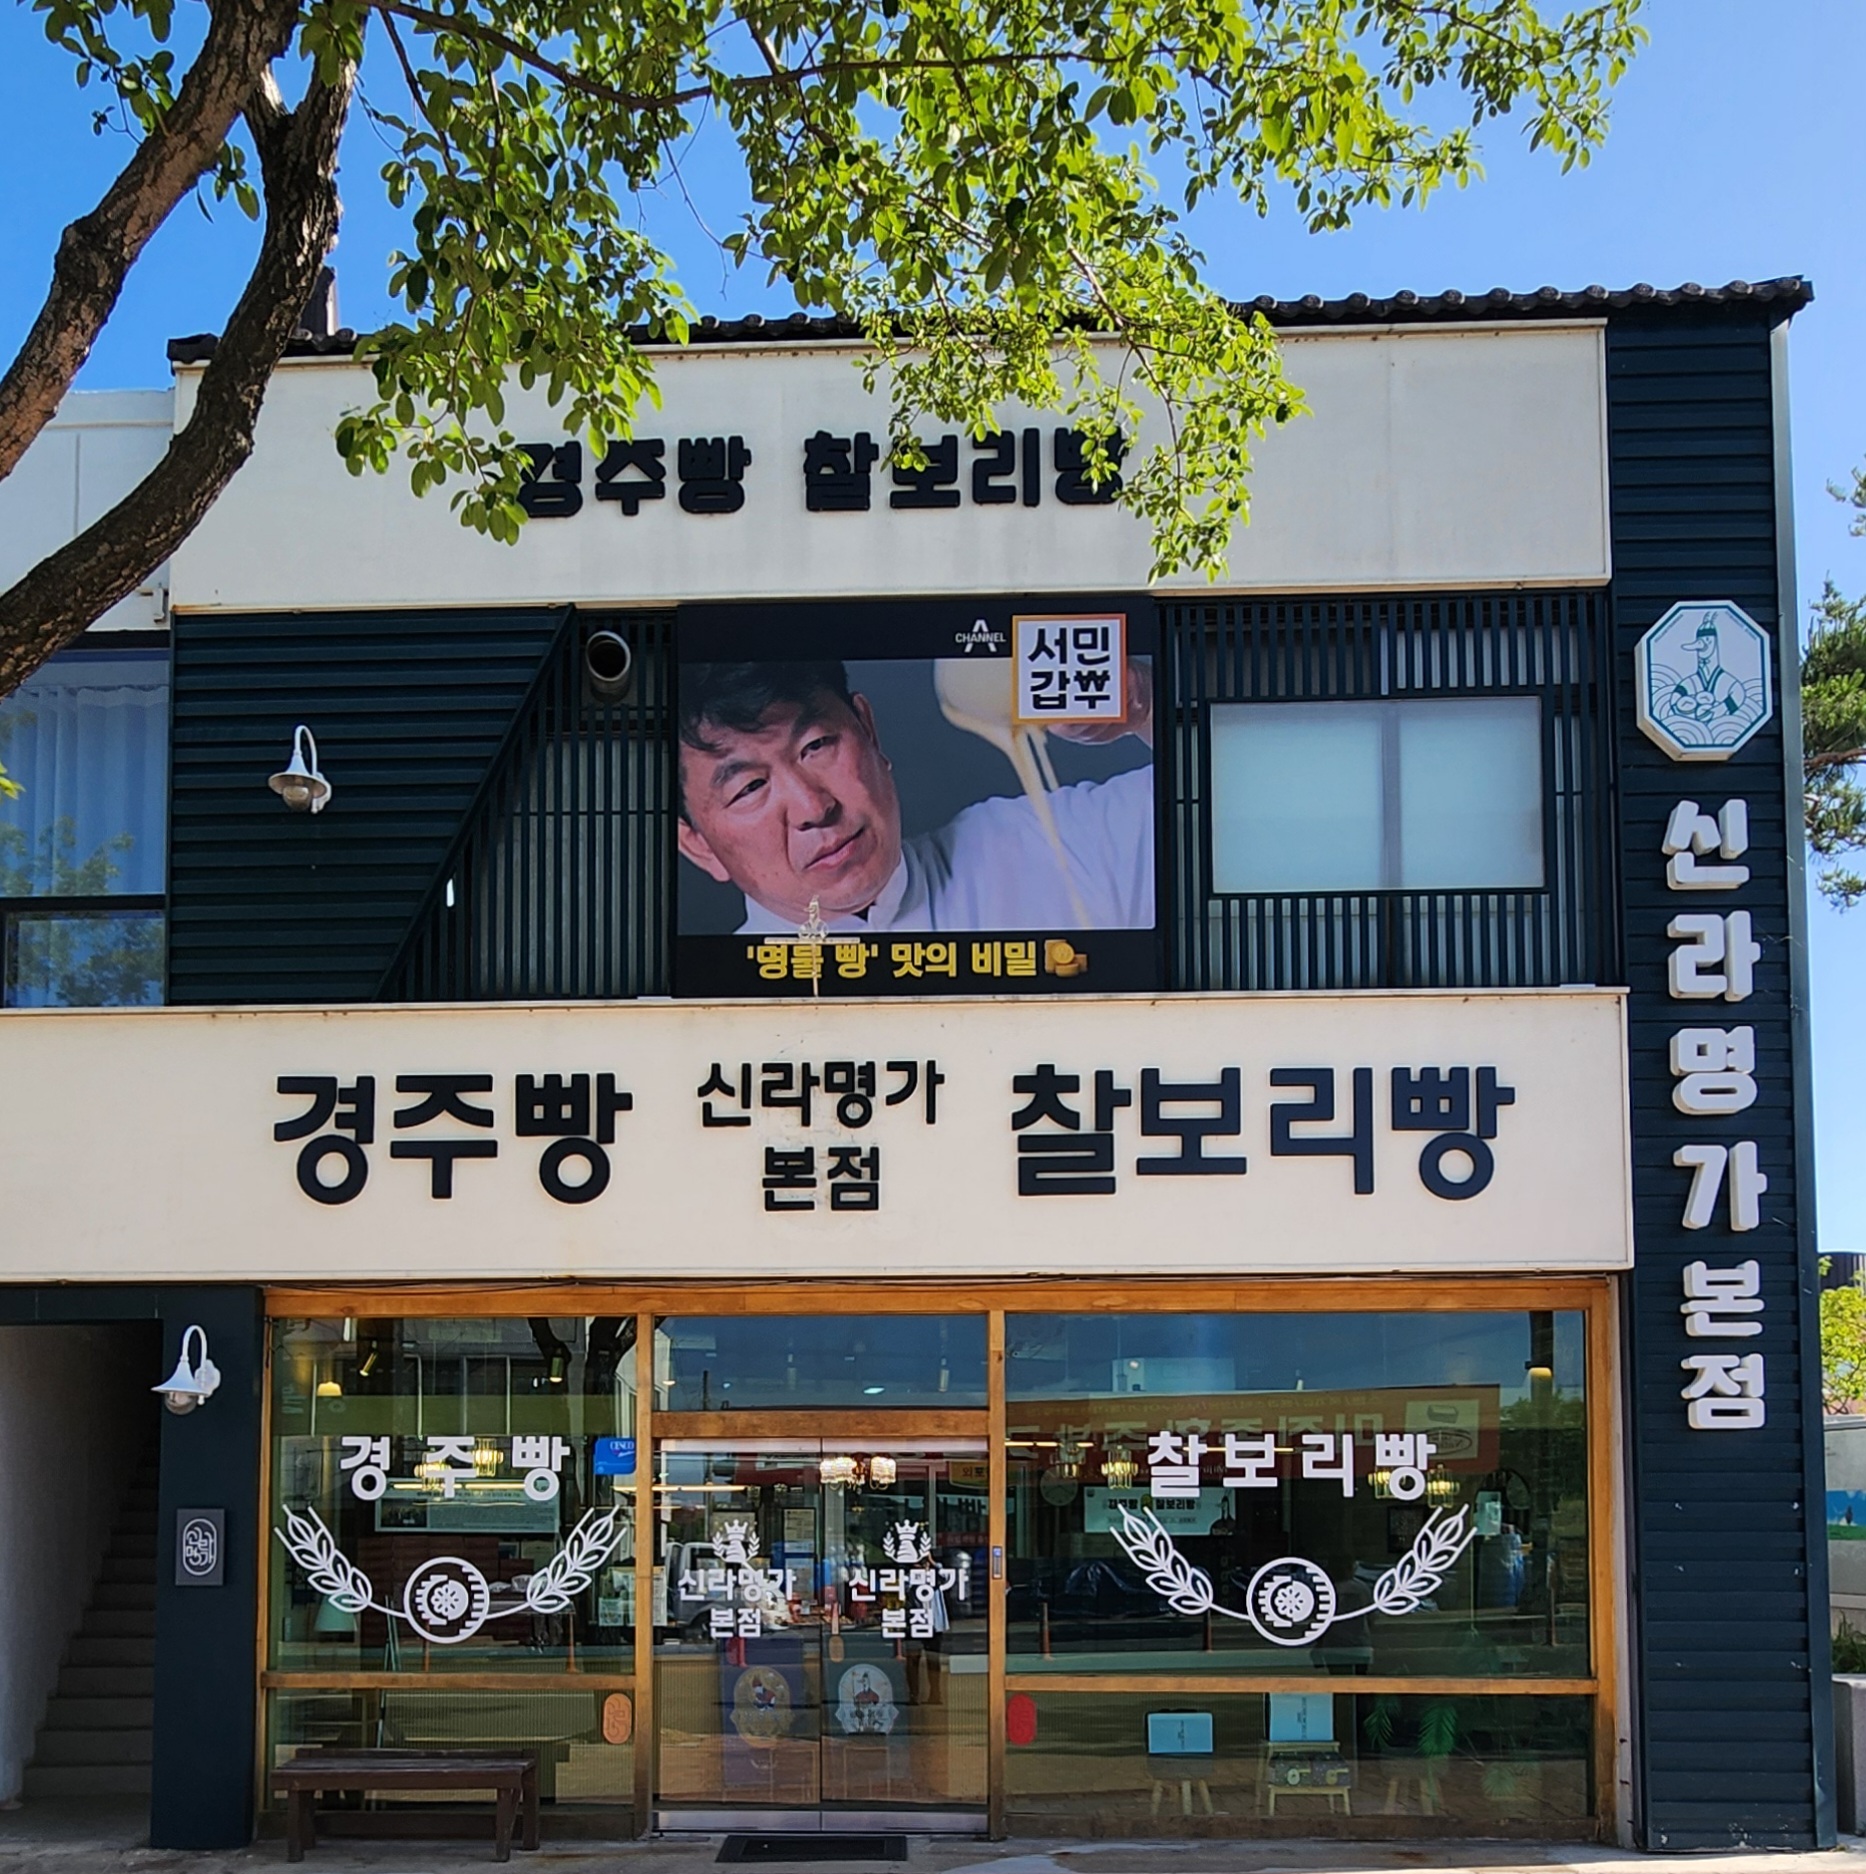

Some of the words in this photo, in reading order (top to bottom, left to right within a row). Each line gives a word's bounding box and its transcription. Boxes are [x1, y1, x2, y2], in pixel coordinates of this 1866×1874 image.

[517, 435, 751, 517] 경주빵
[803, 427, 1133, 512] 찰보리빵
[955, 632, 1006, 643] CHANNEL
[1027, 627, 1110, 666] 서민
[892, 942, 957, 977] 맛의
[972, 941, 1037, 976] 비밀
[698, 1060, 945, 1128] 신라명가
[274, 1073, 633, 1204] 경주빵
[1012, 1064, 1515, 1200] 찰보리빵
[763, 1146, 880, 1211] 본점
[1148, 1431, 1437, 1500] 찰보리빵
[677, 1569, 796, 1601] 신라명가
[849, 1569, 969, 1601] 신라명가
[709, 1608, 761, 1638] 본점
[881, 1608, 934, 1638] 본점
